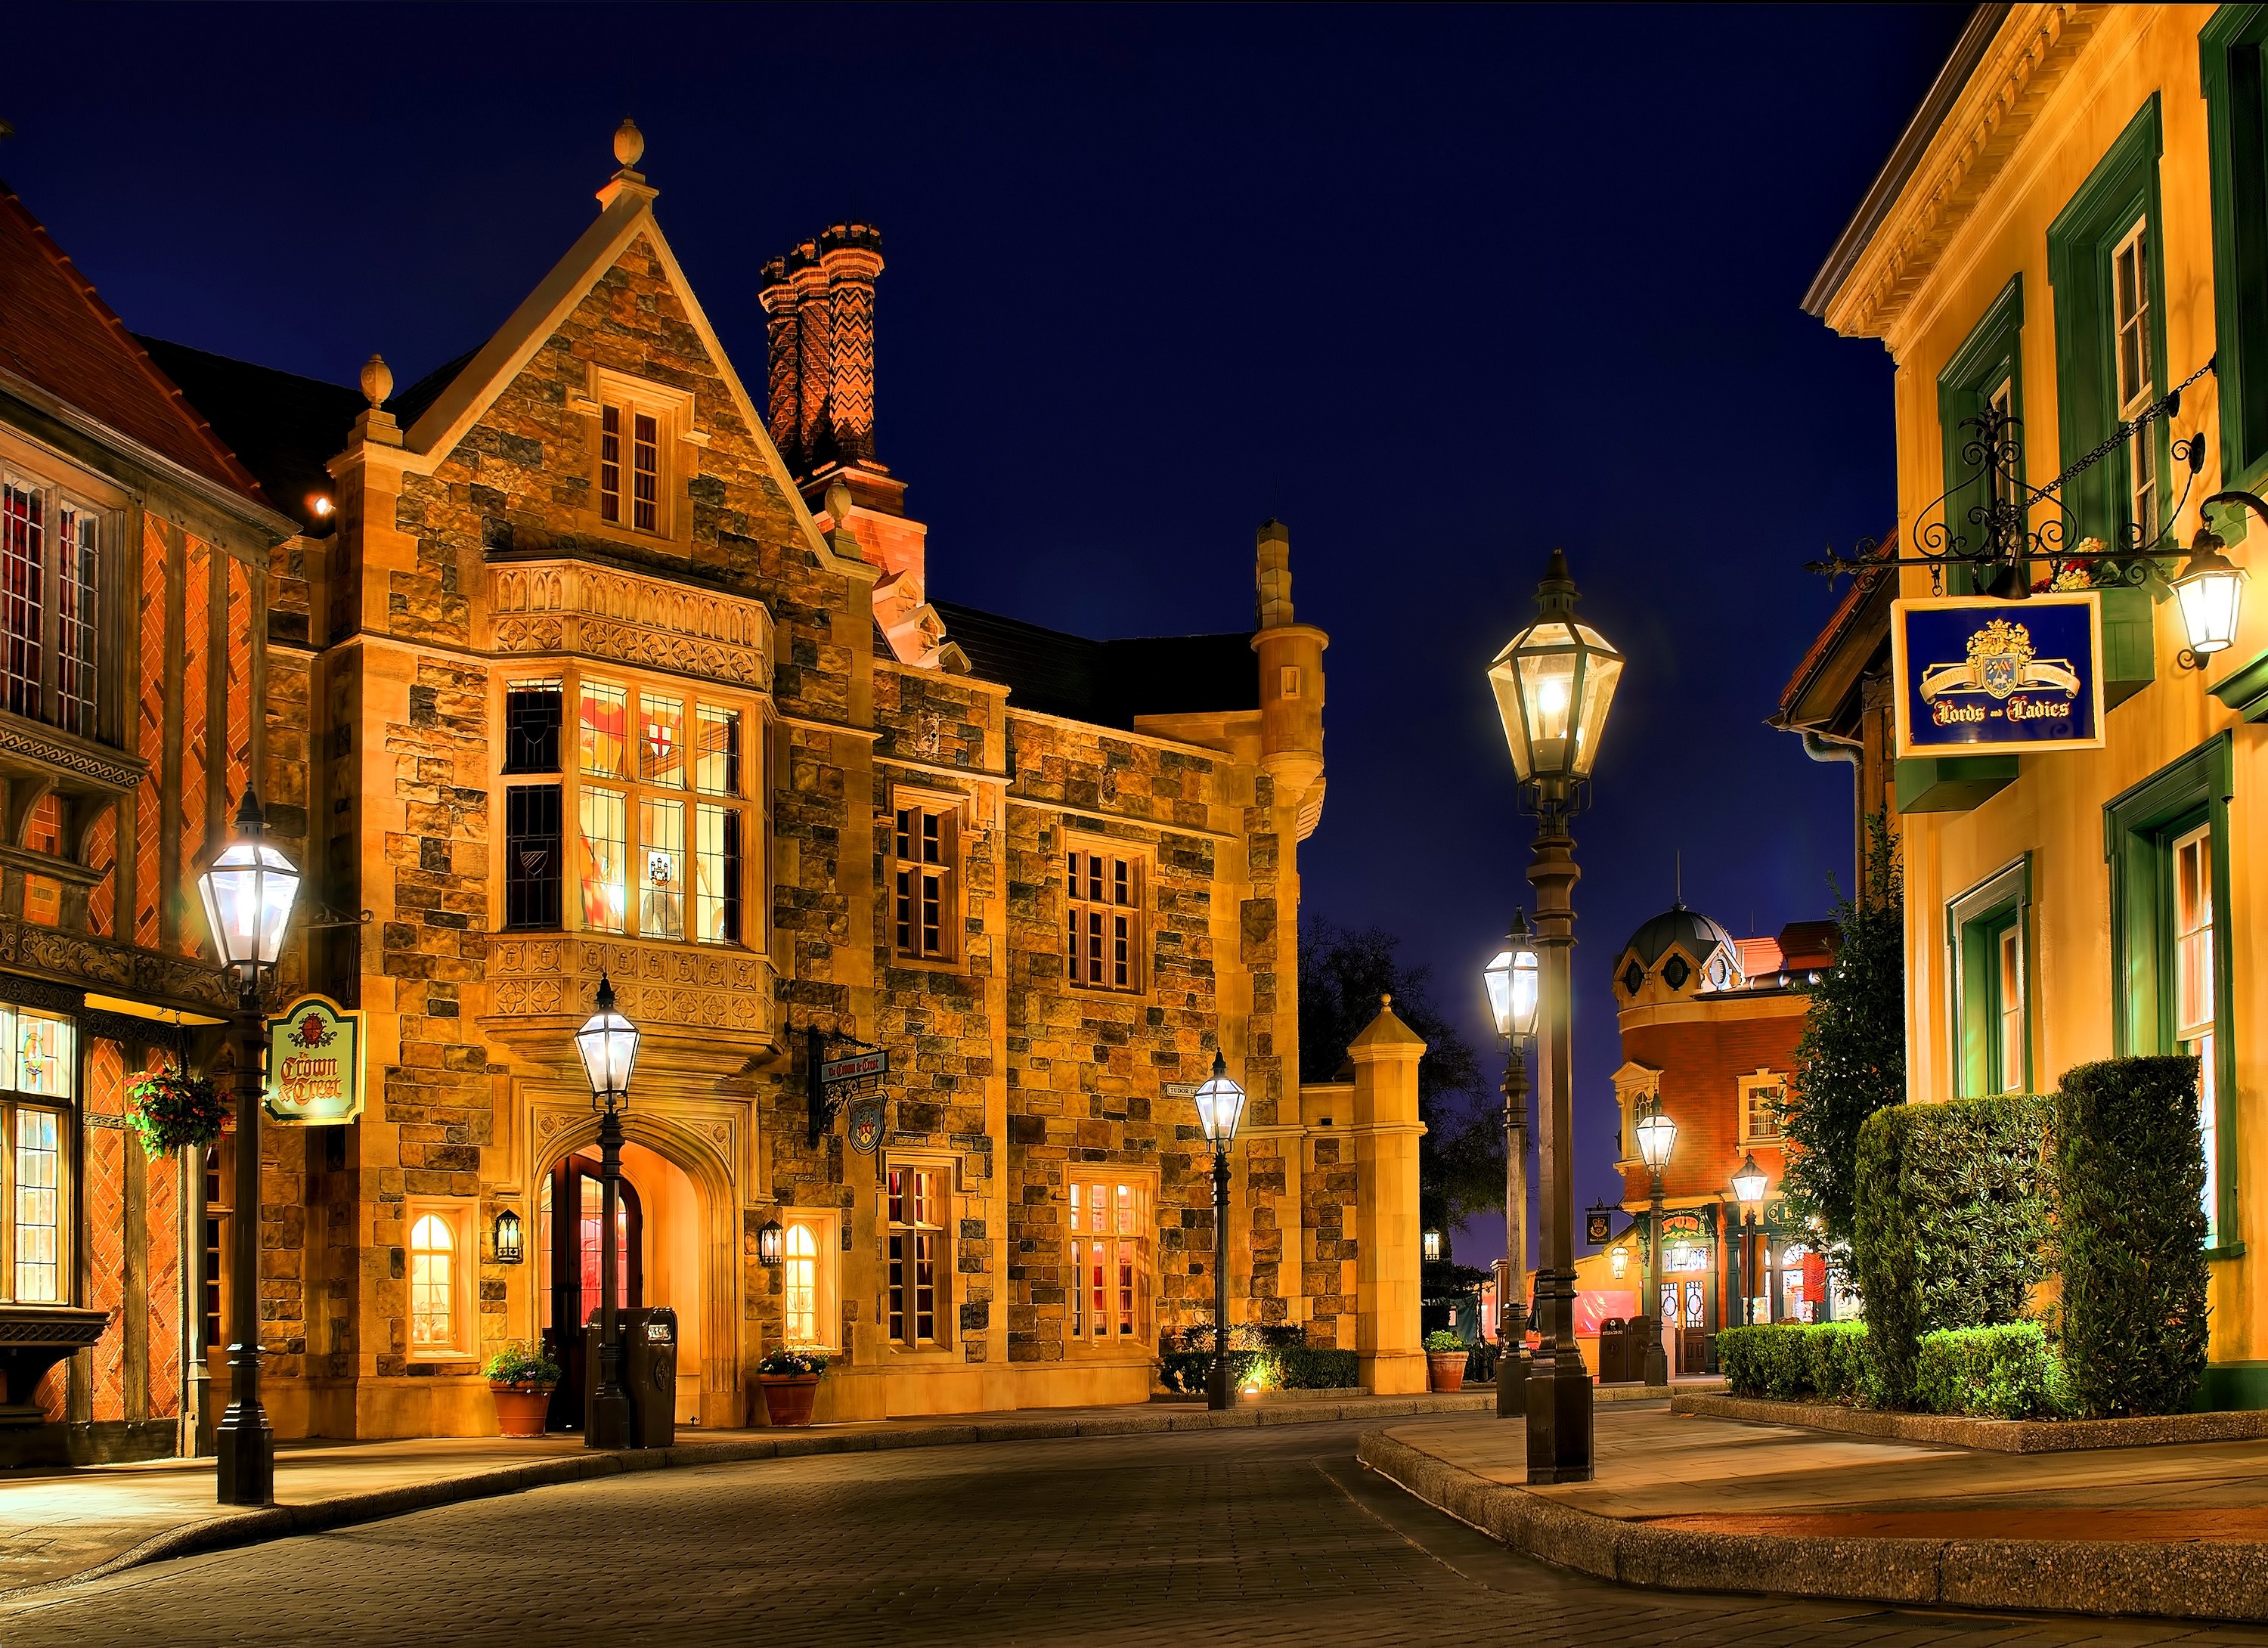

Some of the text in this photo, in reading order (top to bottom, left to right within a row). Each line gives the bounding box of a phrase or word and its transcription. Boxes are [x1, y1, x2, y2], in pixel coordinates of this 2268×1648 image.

[1932, 695, 2071, 726] Lords and Ladies
[280, 1057, 337, 1084] Crown
[836, 1063, 855, 1077] Crown
[856, 1062, 862, 1072] &
[278, 1078, 343, 1106] & Crest
[1662, 1216, 1699, 1234] PUB
